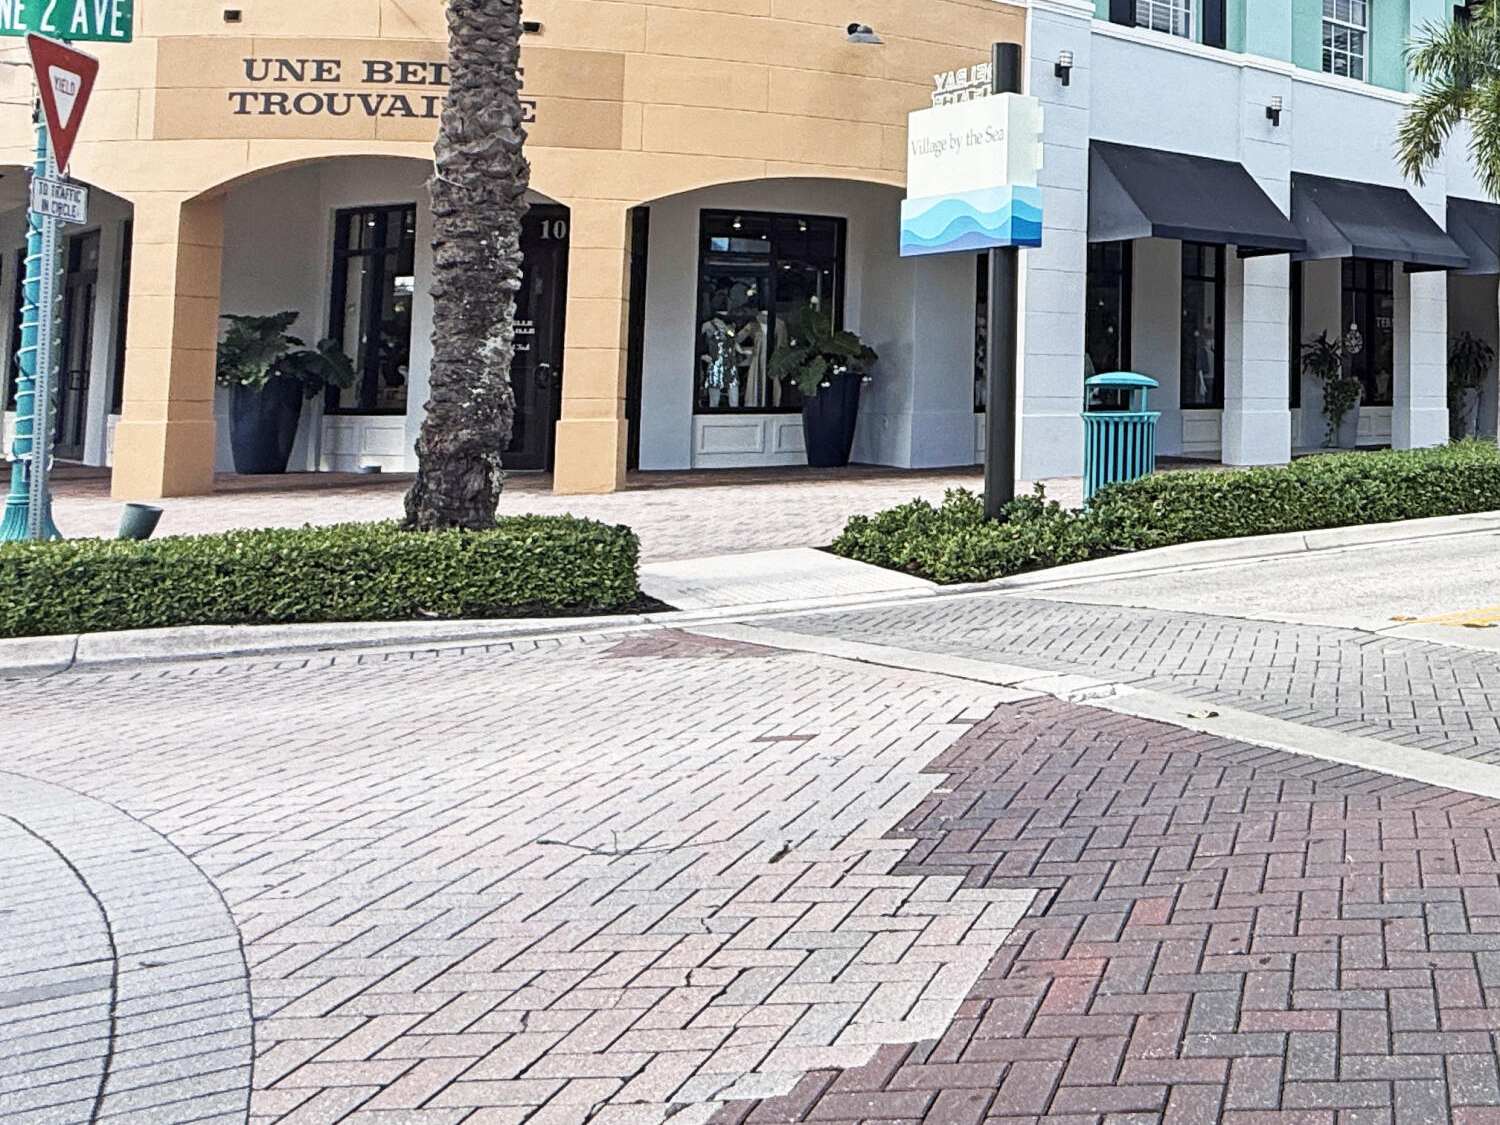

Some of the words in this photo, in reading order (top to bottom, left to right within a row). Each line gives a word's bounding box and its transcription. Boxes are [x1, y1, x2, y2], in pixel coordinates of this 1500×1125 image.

[243, 58, 341, 82] UNE
[54, 75, 76, 96] YIELD
[911, 135, 947, 158] Village
[949, 132, 963, 154] by
[966, 128, 983, 147] the
[985, 125, 1005, 143] Sea
[39, 182, 48, 195] TO
[51, 184, 81, 203] TRAFFIC
[42, 199, 49, 212] IN
[52, 200, 77, 218] CIRCLE
[540, 220, 567, 239] 10
